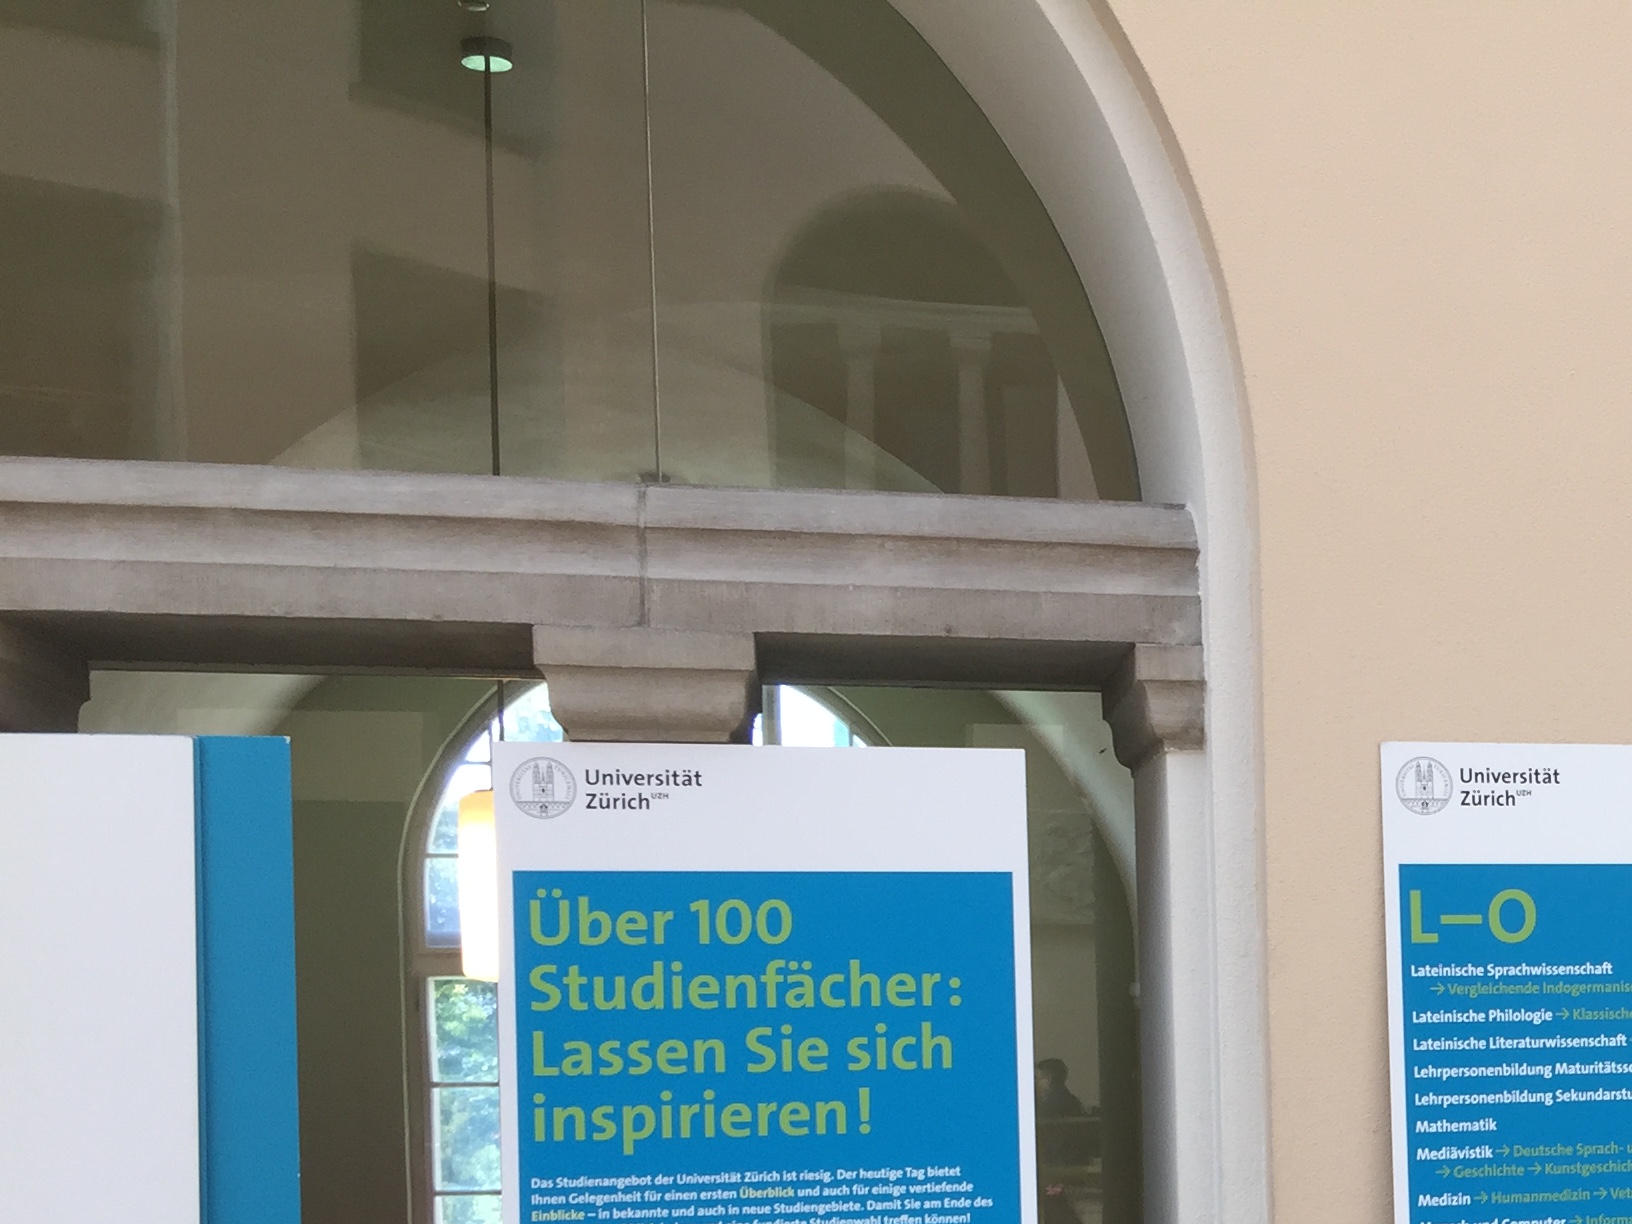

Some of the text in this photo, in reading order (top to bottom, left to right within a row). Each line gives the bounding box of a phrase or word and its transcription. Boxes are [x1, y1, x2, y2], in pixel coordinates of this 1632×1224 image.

[585, 768, 702, 787] Universität
[1459, 767, 1560, 784] Universität
[529, 888, 792, 946] Über 100
[1410, 961, 1612, 979] Lateinische Sprachwissenschaft
[1412, 1008, 1553, 1025] Lateinische Philologie
[532, 1021, 952, 1076] Lassen Sie sich
[1412, 1033, 1627, 1051] Lateinische Literaturwissenschaft
[1413, 1062, 1552, 1081] Lehrpersonenbildung
[1414, 1089, 1553, 1108] Lehrpersonenbildung
[1415, 1117, 1497, 1133] Mathematik
[1416, 1145, 1493, 1160] Mediävistik
[1417, 1192, 1471, 1207] Medizin
